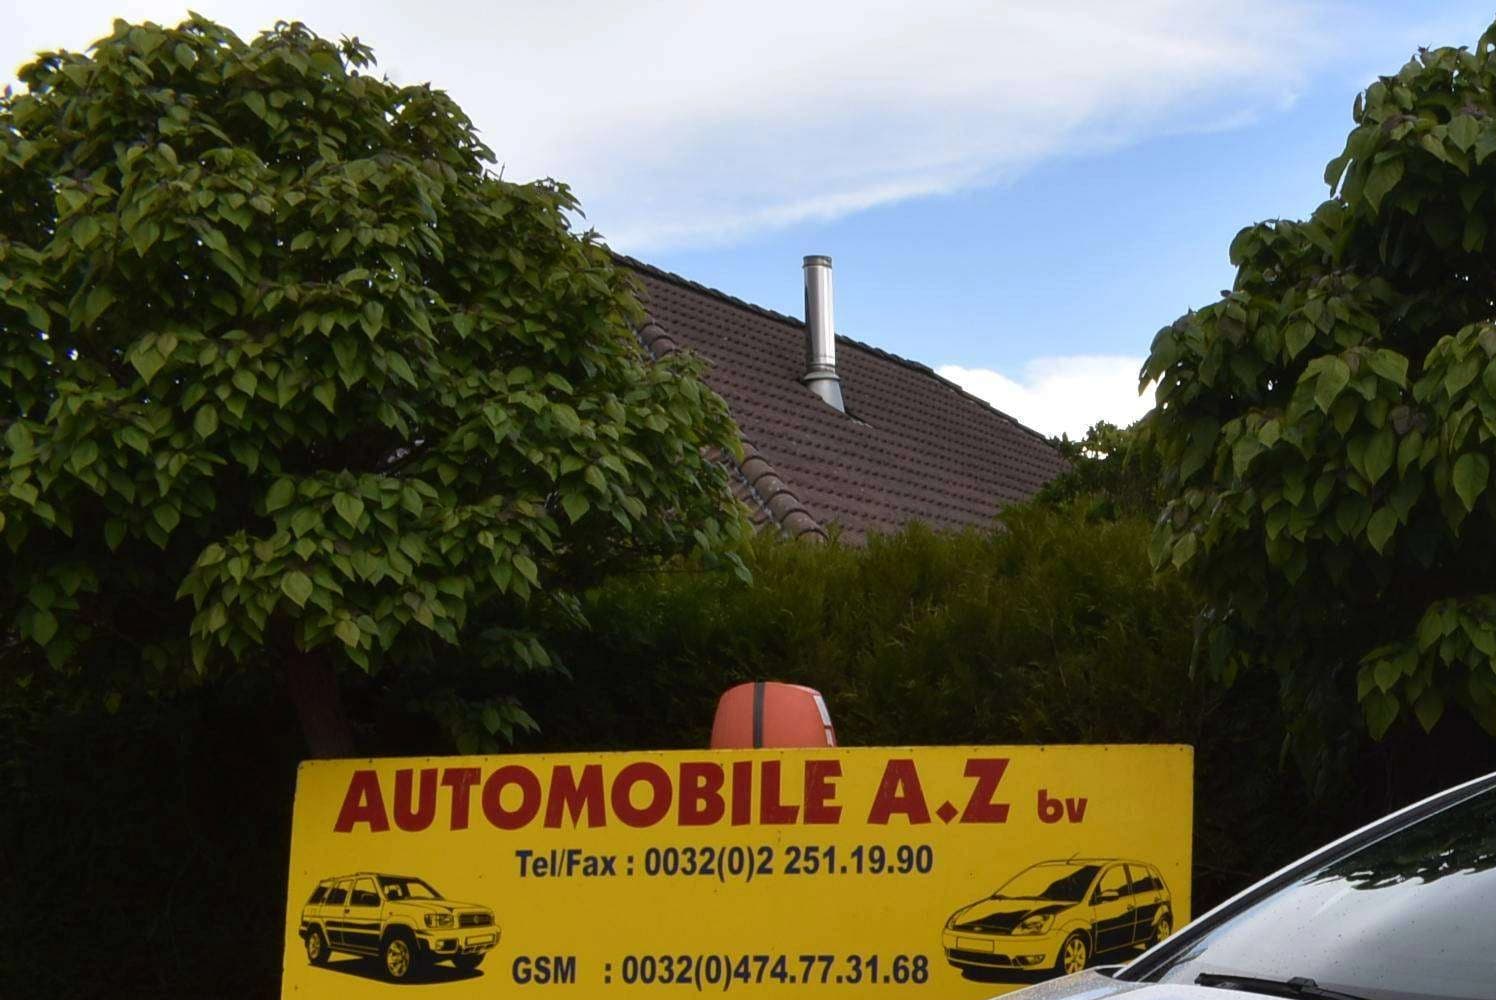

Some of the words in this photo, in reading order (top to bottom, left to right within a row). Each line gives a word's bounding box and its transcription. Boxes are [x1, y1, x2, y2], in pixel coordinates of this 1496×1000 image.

[333, 760, 843, 833] AUTOMOBILE
[867, 758, 1010, 825] A.Z
[1037, 789, 1088, 824] bv
[515, 848, 616, 877] Tel/Fax
[644, 845, 774, 883] 0032(0)2
[783, 844, 934, 875] 251.19.90
[511, 955, 577, 985] GSM
[621, 953, 929, 992] 0032(0)474.77.31.68
